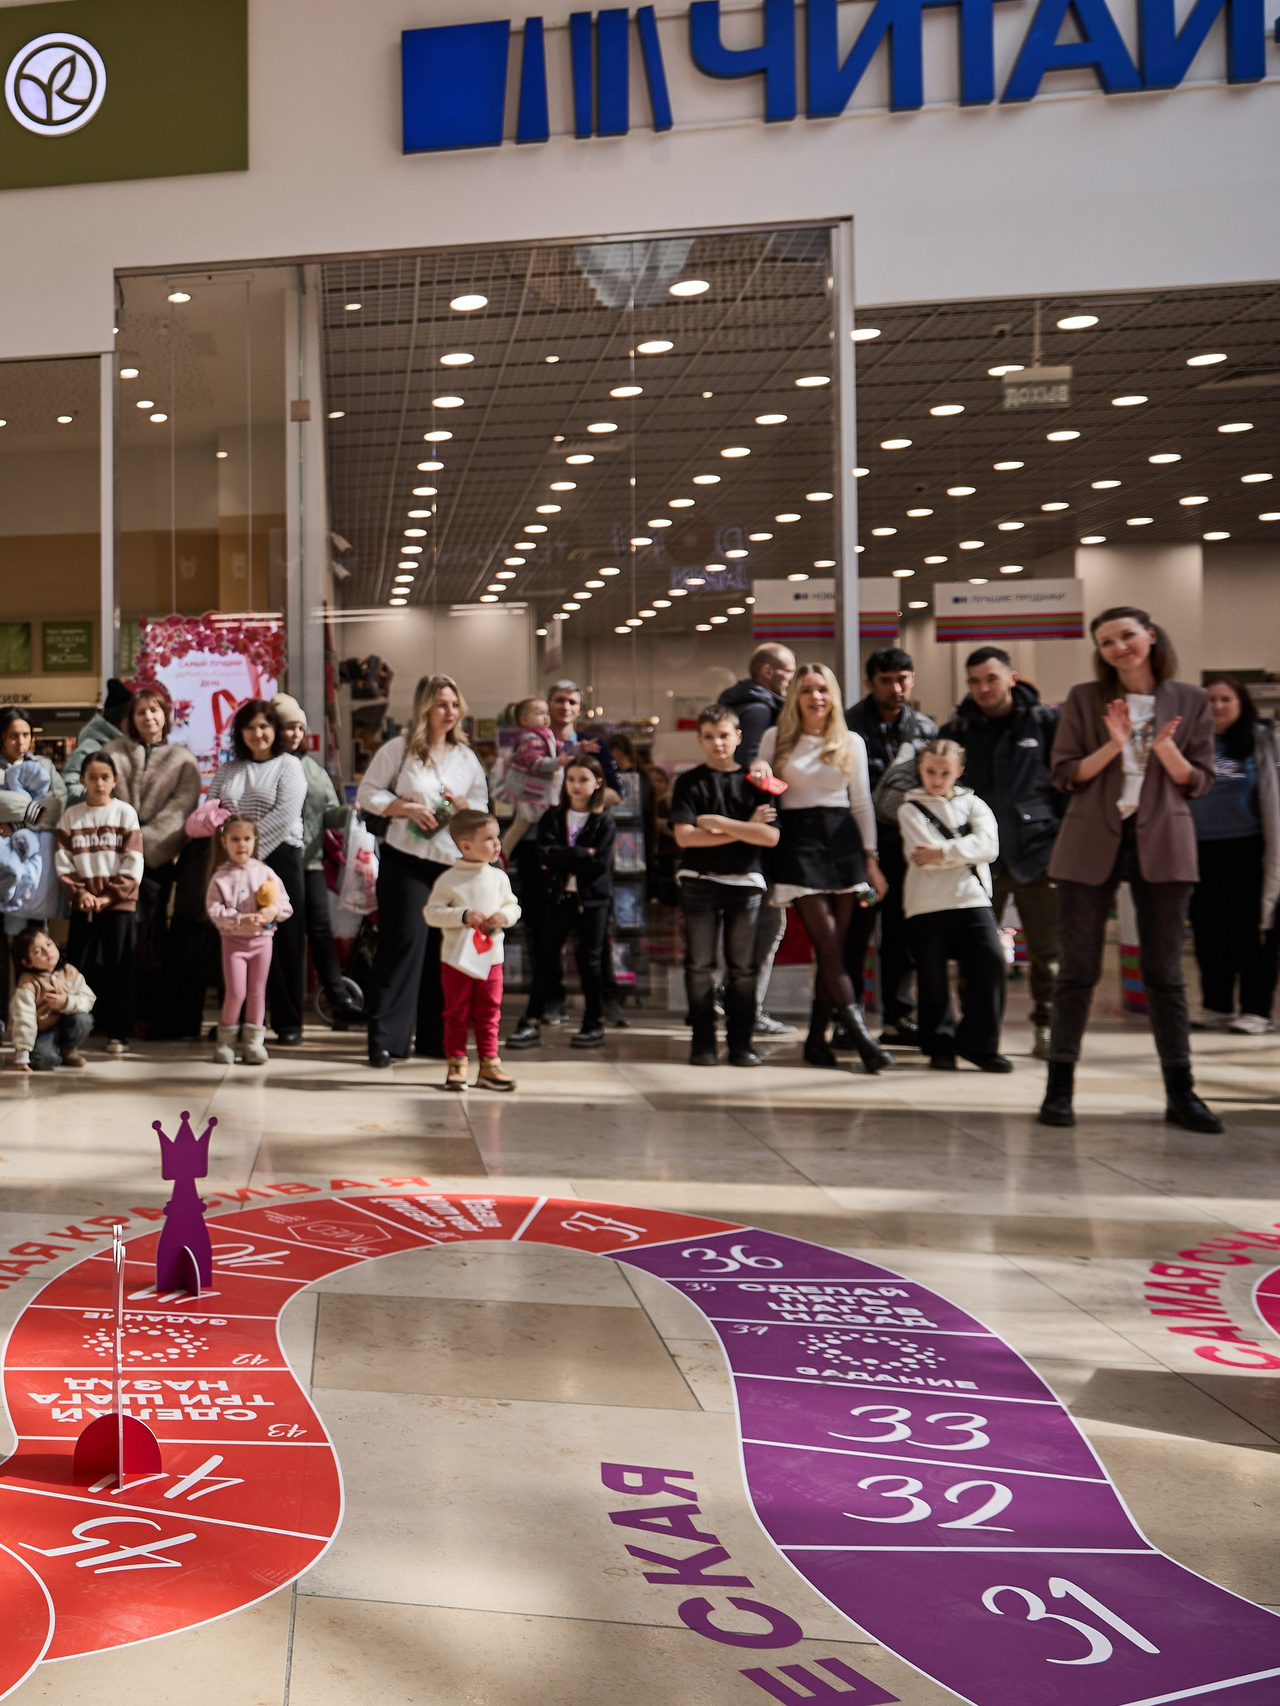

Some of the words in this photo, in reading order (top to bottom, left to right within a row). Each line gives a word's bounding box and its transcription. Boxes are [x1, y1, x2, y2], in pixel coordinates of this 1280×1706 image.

[178, 660, 207, 668] САМЫЙ
[209, 659, 243, 668] ЛУЧШИЙ
[560, 1210, 648, 1243] 37
[681, 1244, 784, 1273] 36
[684, 1282, 718, 1293] 35
[737, 1283, 910, 1298] СДЕЛАЙ
[779, 1293, 890, 1305] ПЯТЬ
[767, 1301, 924, 1316] ШАГОВ
[1143, 1262, 1280, 1370] САМАЯ
[781, 1312, 939, 1329] НАЗАД
[231, 1353, 270, 1366] 42
[63, 1377, 230, 1391] НАЗАД
[795, 1366, 980, 1390] ЗАДАНИЕ
[27, 1393, 164, 1405] ШАГА
[181, 1394, 276, 1406] ТРИ
[267, 1423, 308, 1438] 43
[827, 1404, 991, 1451] 33
[842, 1474, 1015, 1533] 32
[17, 1515, 198, 1575] 45
[981, 1576, 1161, 1665] 31
